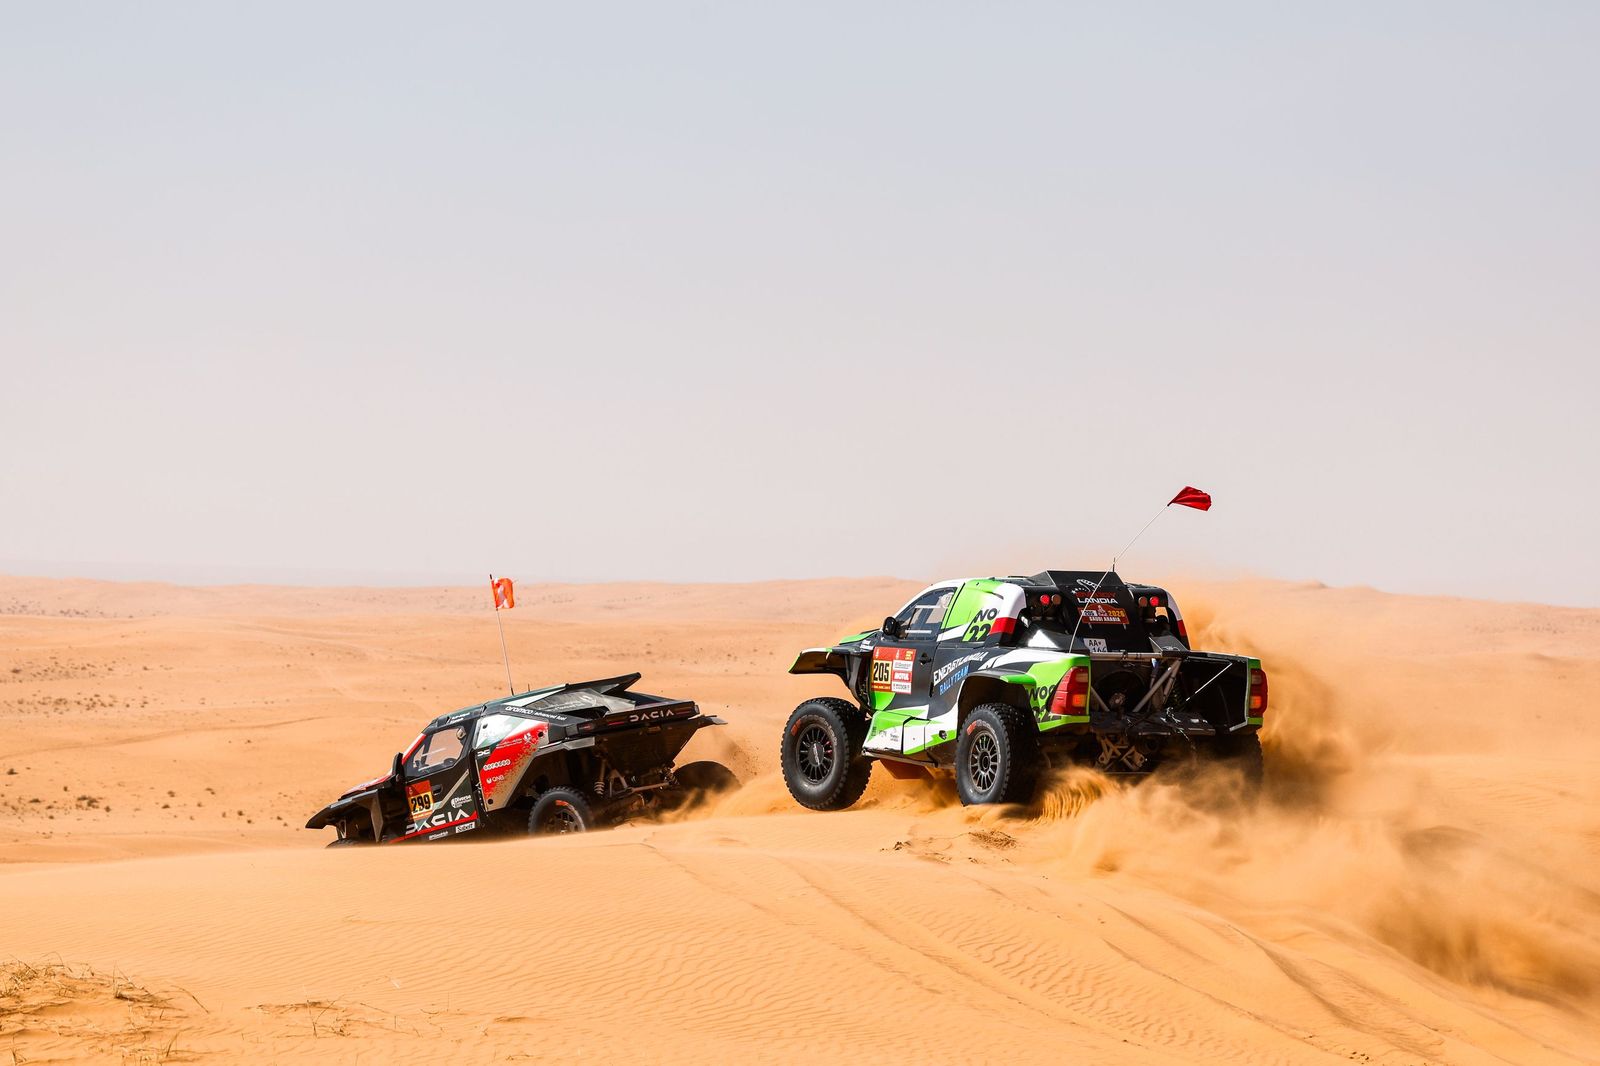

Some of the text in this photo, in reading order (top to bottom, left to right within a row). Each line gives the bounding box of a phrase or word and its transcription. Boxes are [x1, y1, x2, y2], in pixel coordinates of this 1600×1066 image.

[1077, 597, 1119, 605] LANDIA
[968, 623, 992, 641] 22
[873, 661, 890, 682] 205
[954, 664, 969, 684] TEAM
[505, 705, 533, 715] aramco
[629, 709, 675, 722] DACIA
[411, 794, 431, 813] 299
[405, 808, 471, 835] DACIA
